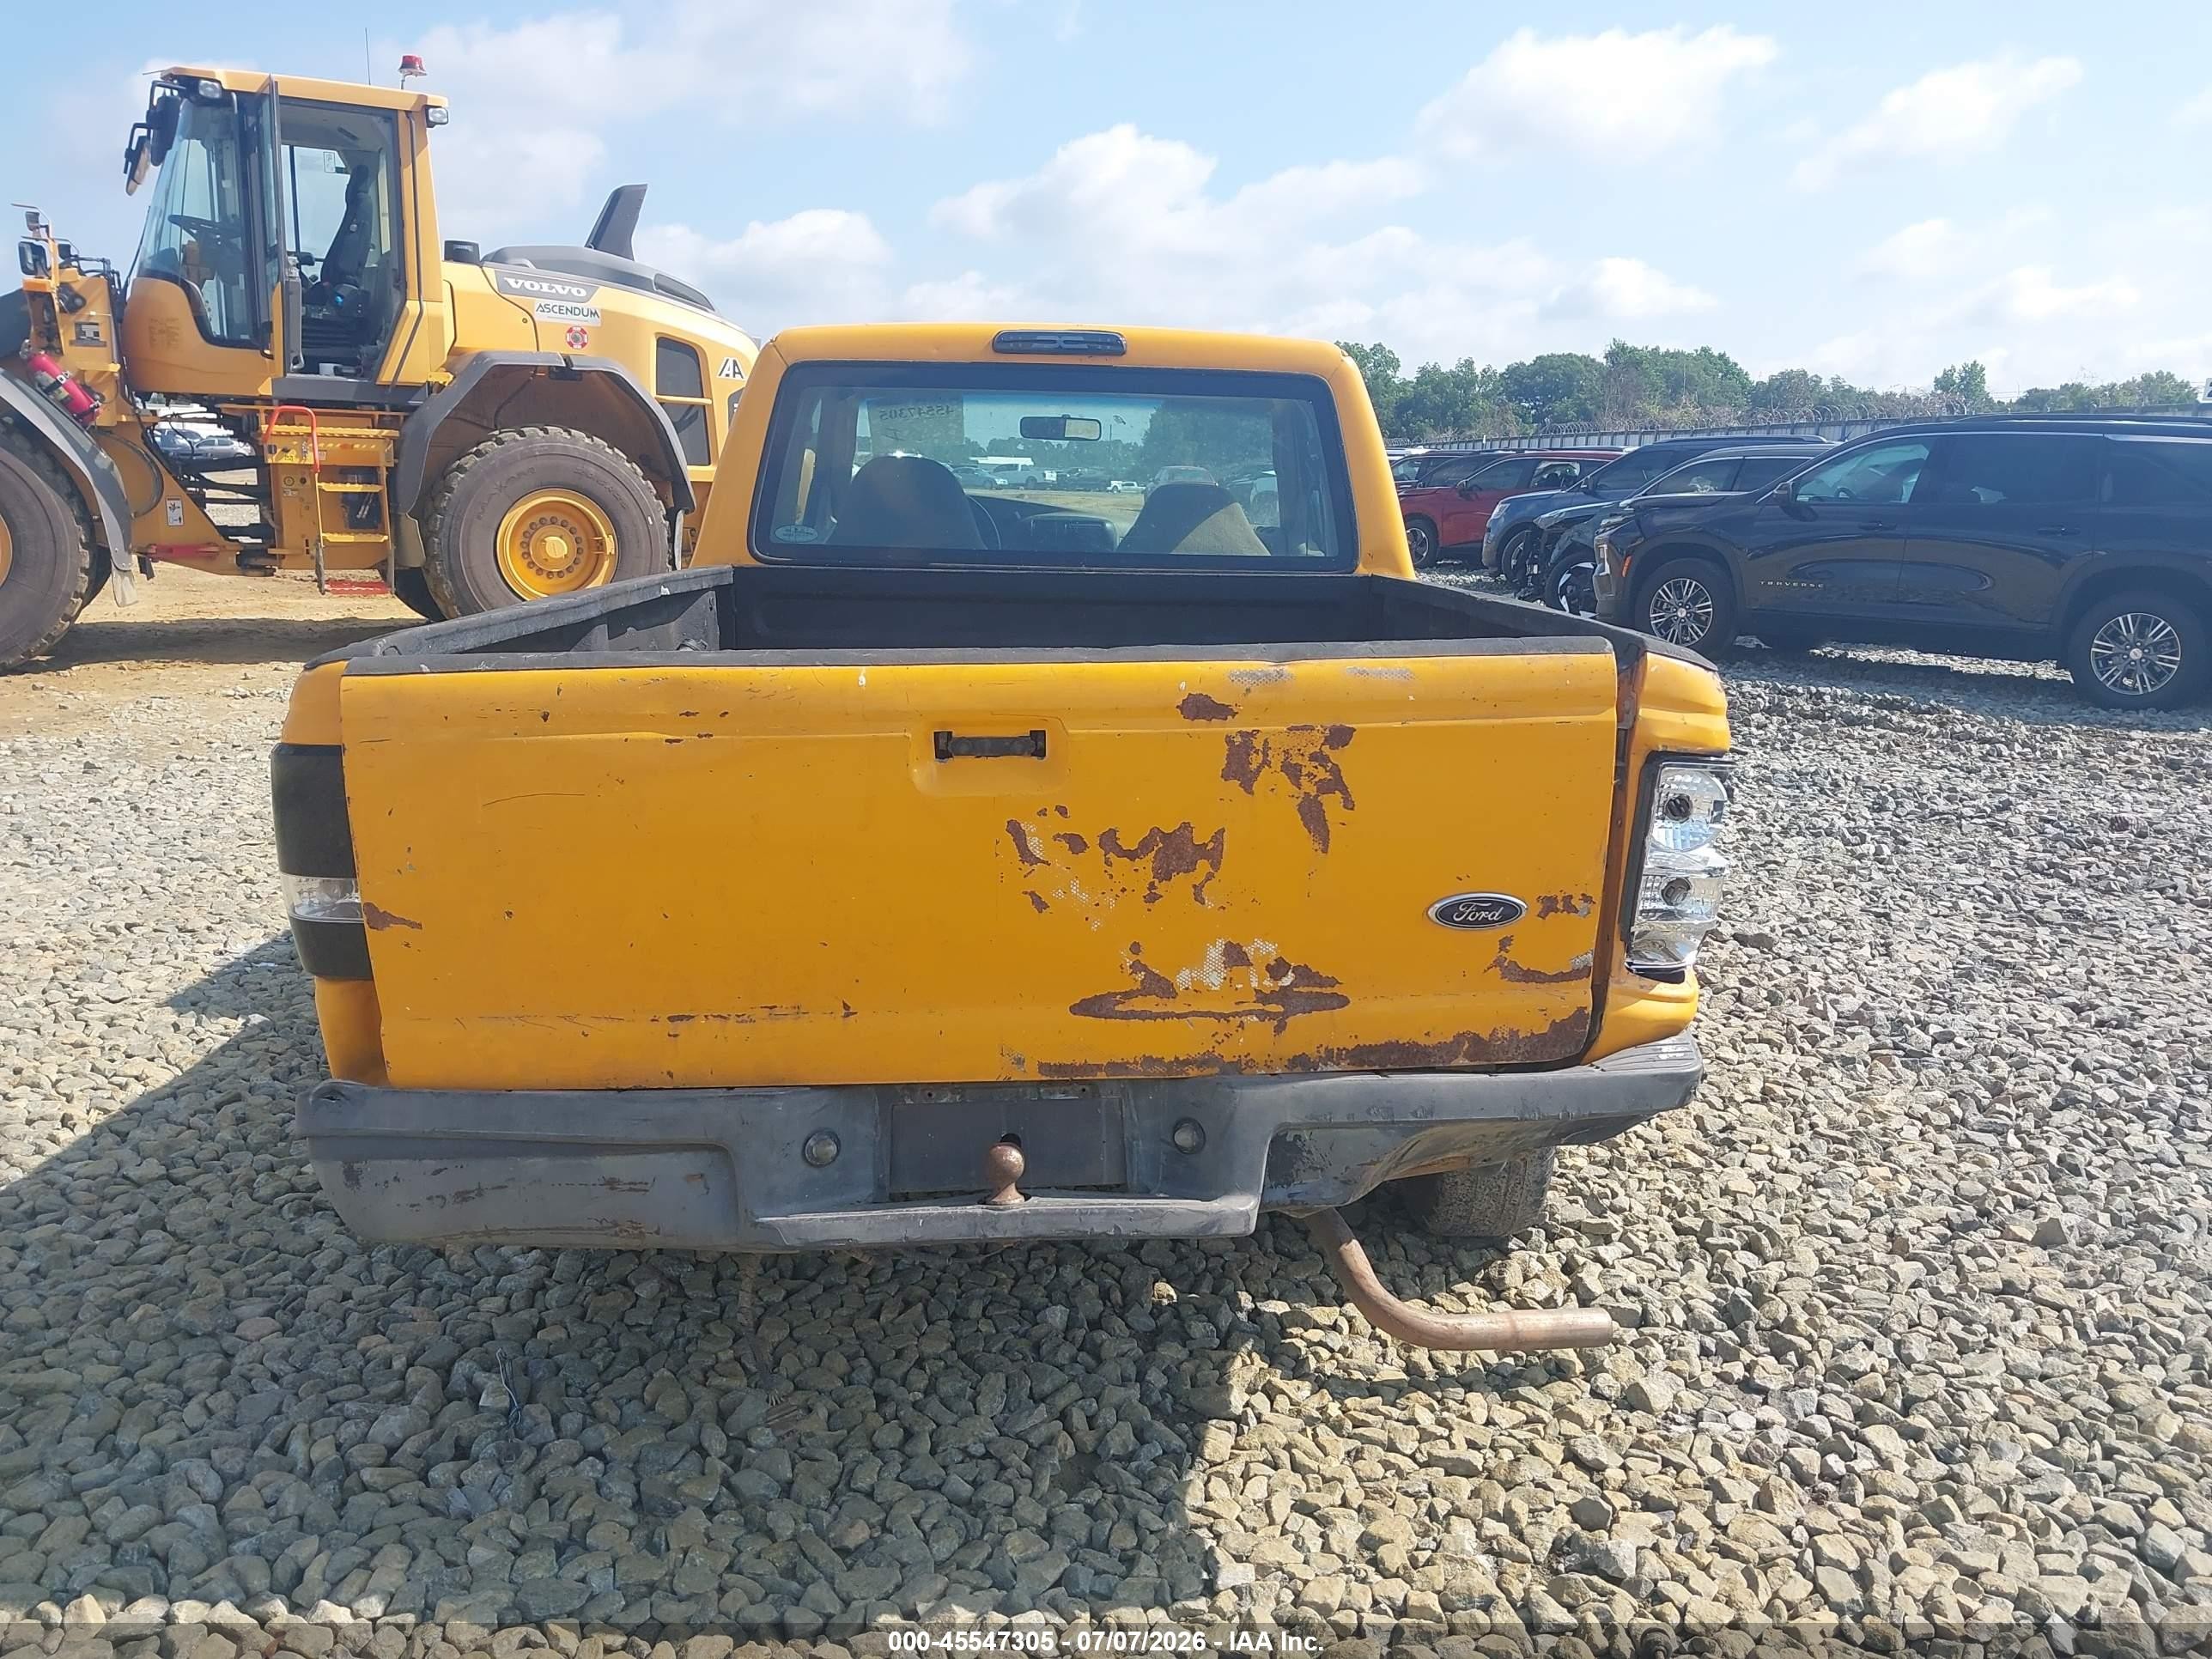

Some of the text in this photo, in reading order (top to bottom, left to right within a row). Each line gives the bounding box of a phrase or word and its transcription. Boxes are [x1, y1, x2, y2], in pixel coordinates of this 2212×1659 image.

[503, 276, 586, 297] VOLVO
[536, 302, 599, 319] ASCENDUM
[1452, 901, 1504, 921] Ford
